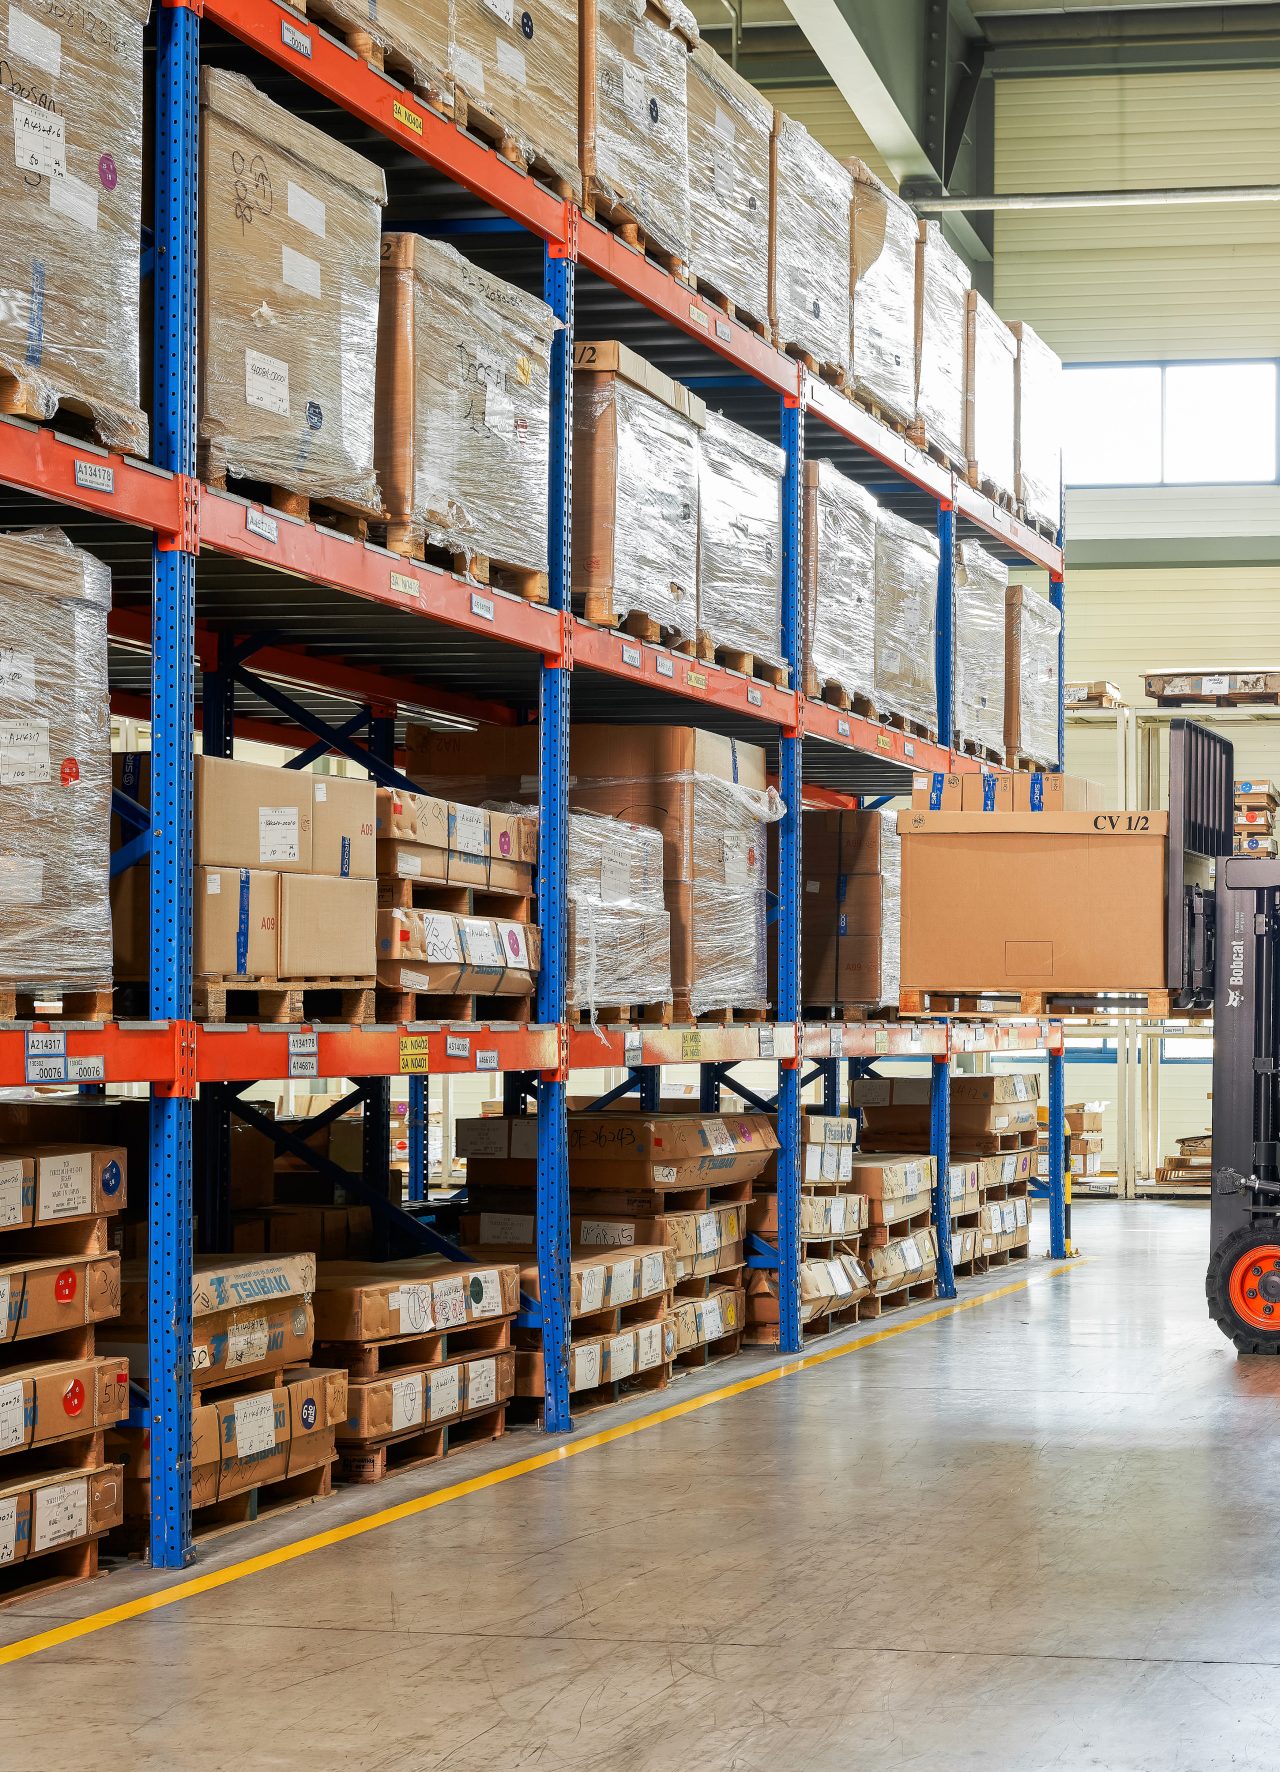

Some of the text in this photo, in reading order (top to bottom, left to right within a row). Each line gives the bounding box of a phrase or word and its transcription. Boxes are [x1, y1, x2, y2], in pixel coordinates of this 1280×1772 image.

[78, 464, 112, 483] A134178
[360, 823, 373, 836] A09
[1094, 815, 1150, 832] CV 1/2
[261, 917, 275, 932] A09
[1229, 940, 1244, 986] Bobcat
[30, 1040, 61, 1050] A214317
[400, 1039, 407, 1051] 3A
[292, 1060, 315, 1071] A146874
[401, 1058, 428, 1069] 3A N0401
[36, 1067, 62, 1079] -00076
[75, 1066, 100, 1078] -00076
[230, 1274, 291, 1304] TSUBAKI
